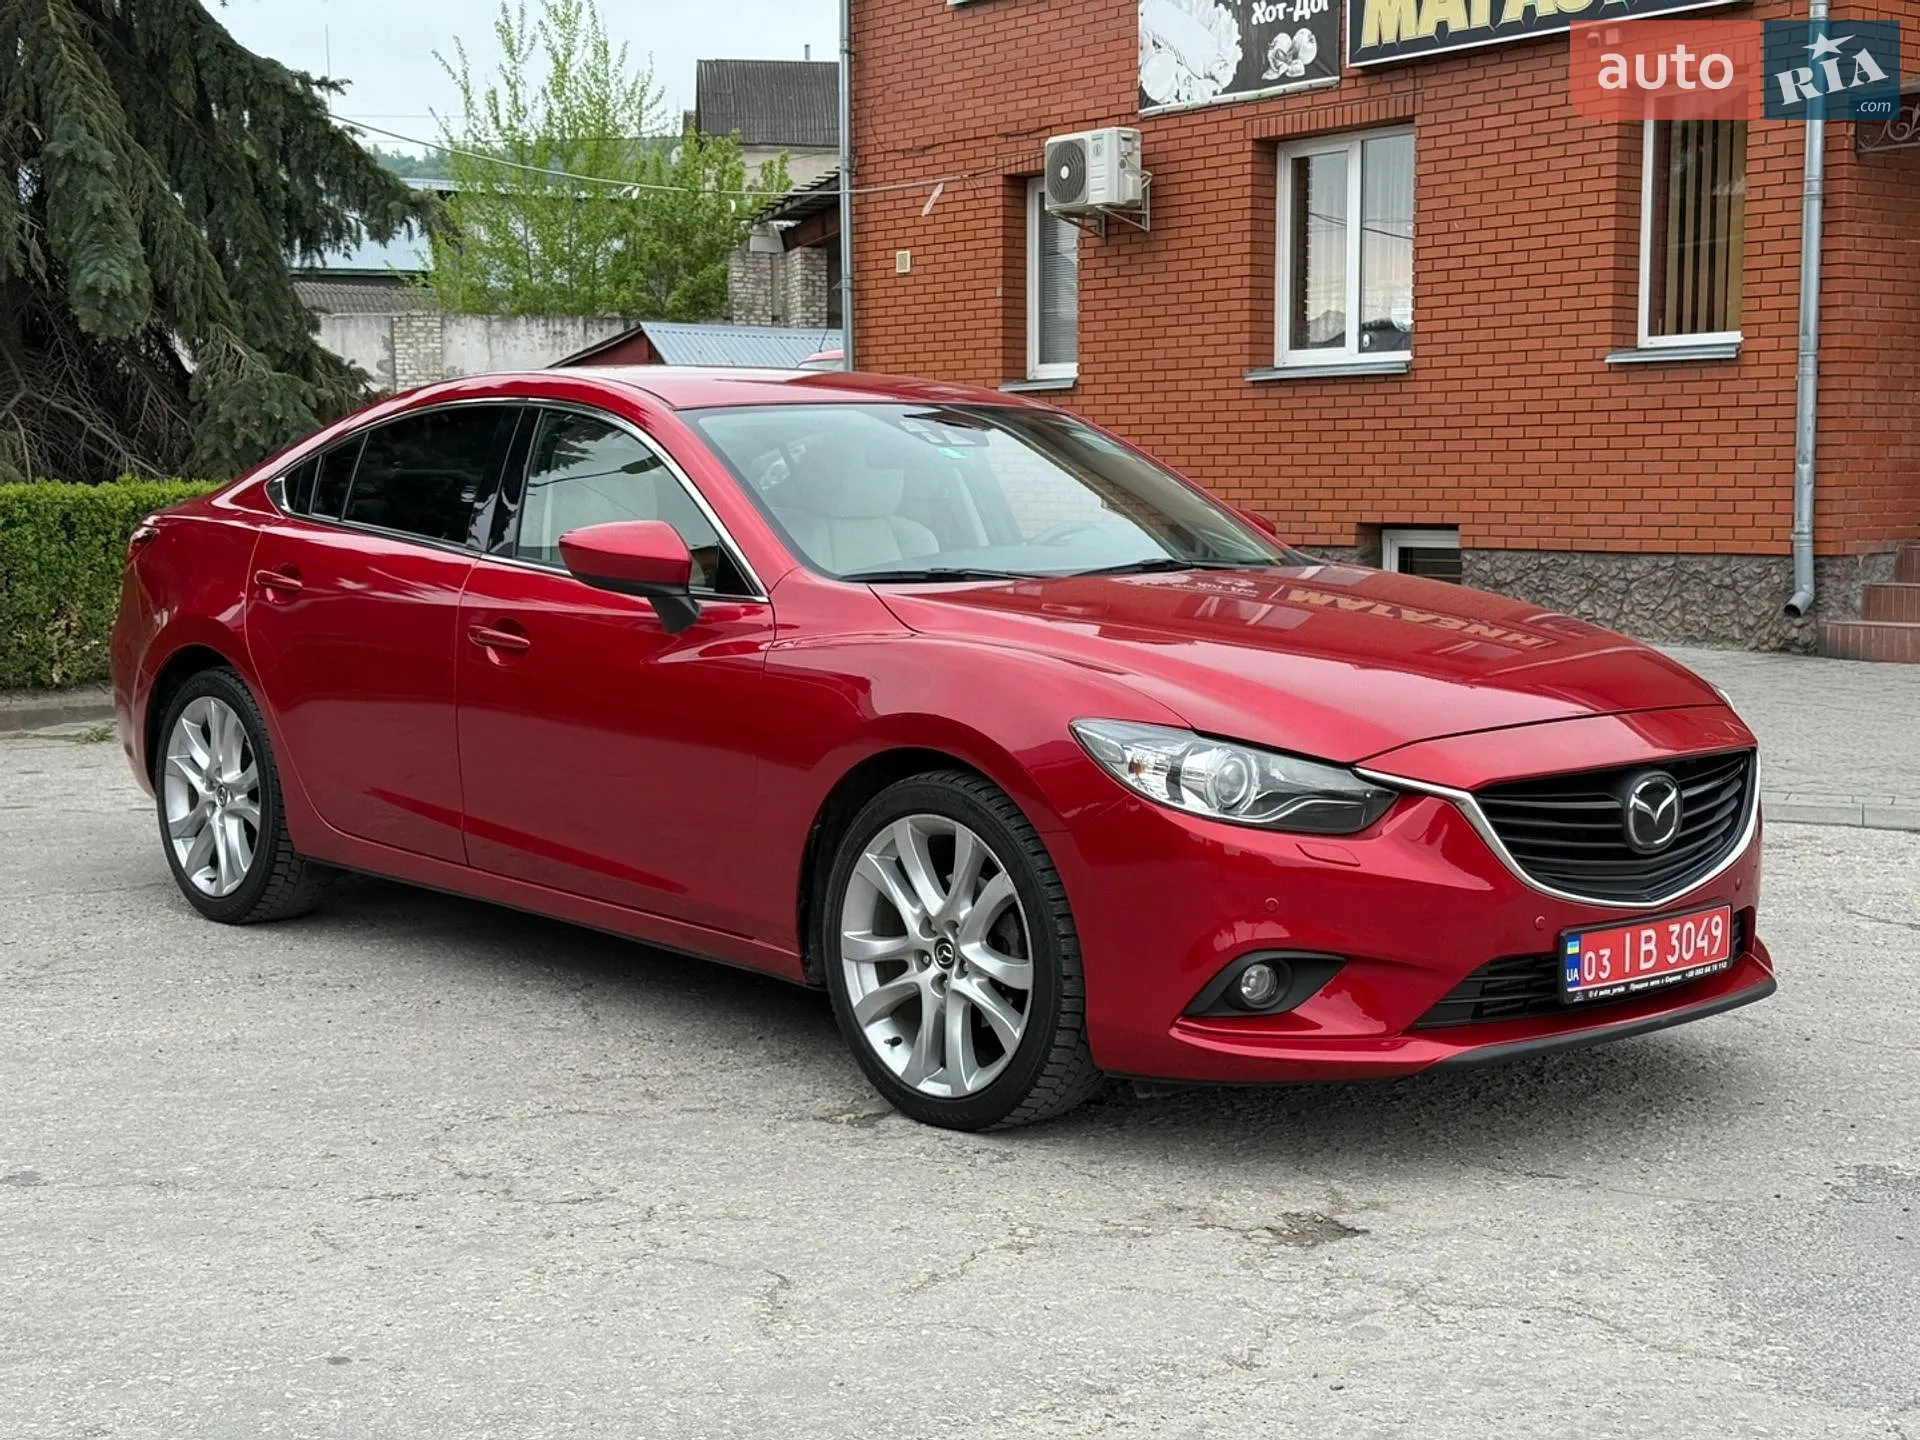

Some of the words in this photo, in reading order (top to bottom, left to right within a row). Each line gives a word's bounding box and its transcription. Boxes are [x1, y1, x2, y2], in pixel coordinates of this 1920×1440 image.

[1584, 948, 1611, 981] 03
[1667, 914, 1723, 965] 3049
[1567, 968, 1579, 982] UA
